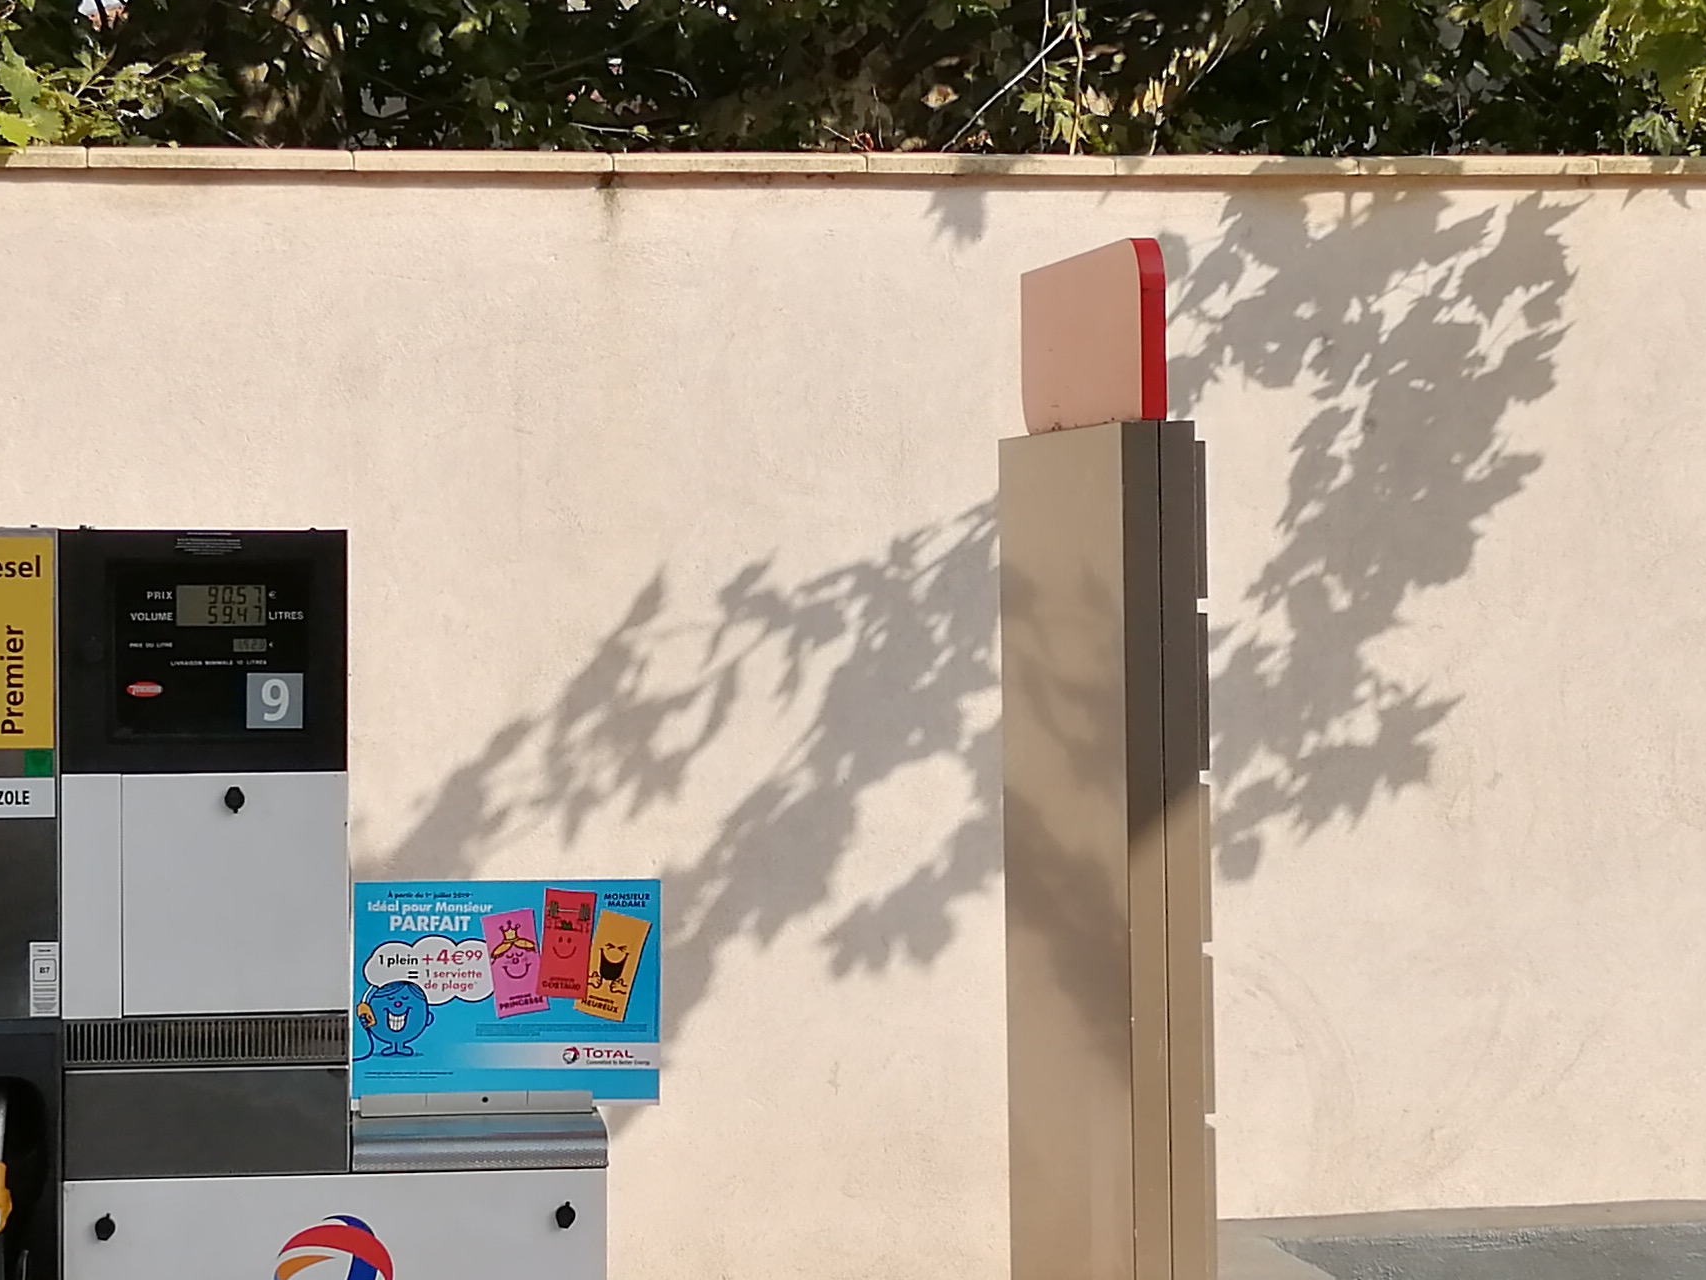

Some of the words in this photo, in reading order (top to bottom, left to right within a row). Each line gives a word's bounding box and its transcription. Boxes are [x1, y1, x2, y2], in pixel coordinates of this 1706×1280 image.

[146, 591, 173, 600] PRIX
[268, 590, 277, 599] €
[130, 612, 173, 621] VOLUME
[268, 611, 304, 620] LITRES
[0, 625, 24, 734] Premier
[261, 678, 290, 722] 9
[603, 893, 650, 901] MONSIEUR
[367, 900, 399, 912] Idéal
[402, 904, 432, 914] pour
[435, 901, 492, 913] Monsieur
[389, 915, 471, 931] PARFAIT
[387, 954, 419, 967] plein
[433, 968, 482, 978] serviette
[424, 980, 438, 990] de
[583, 1047, 634, 1059] TOTAL
